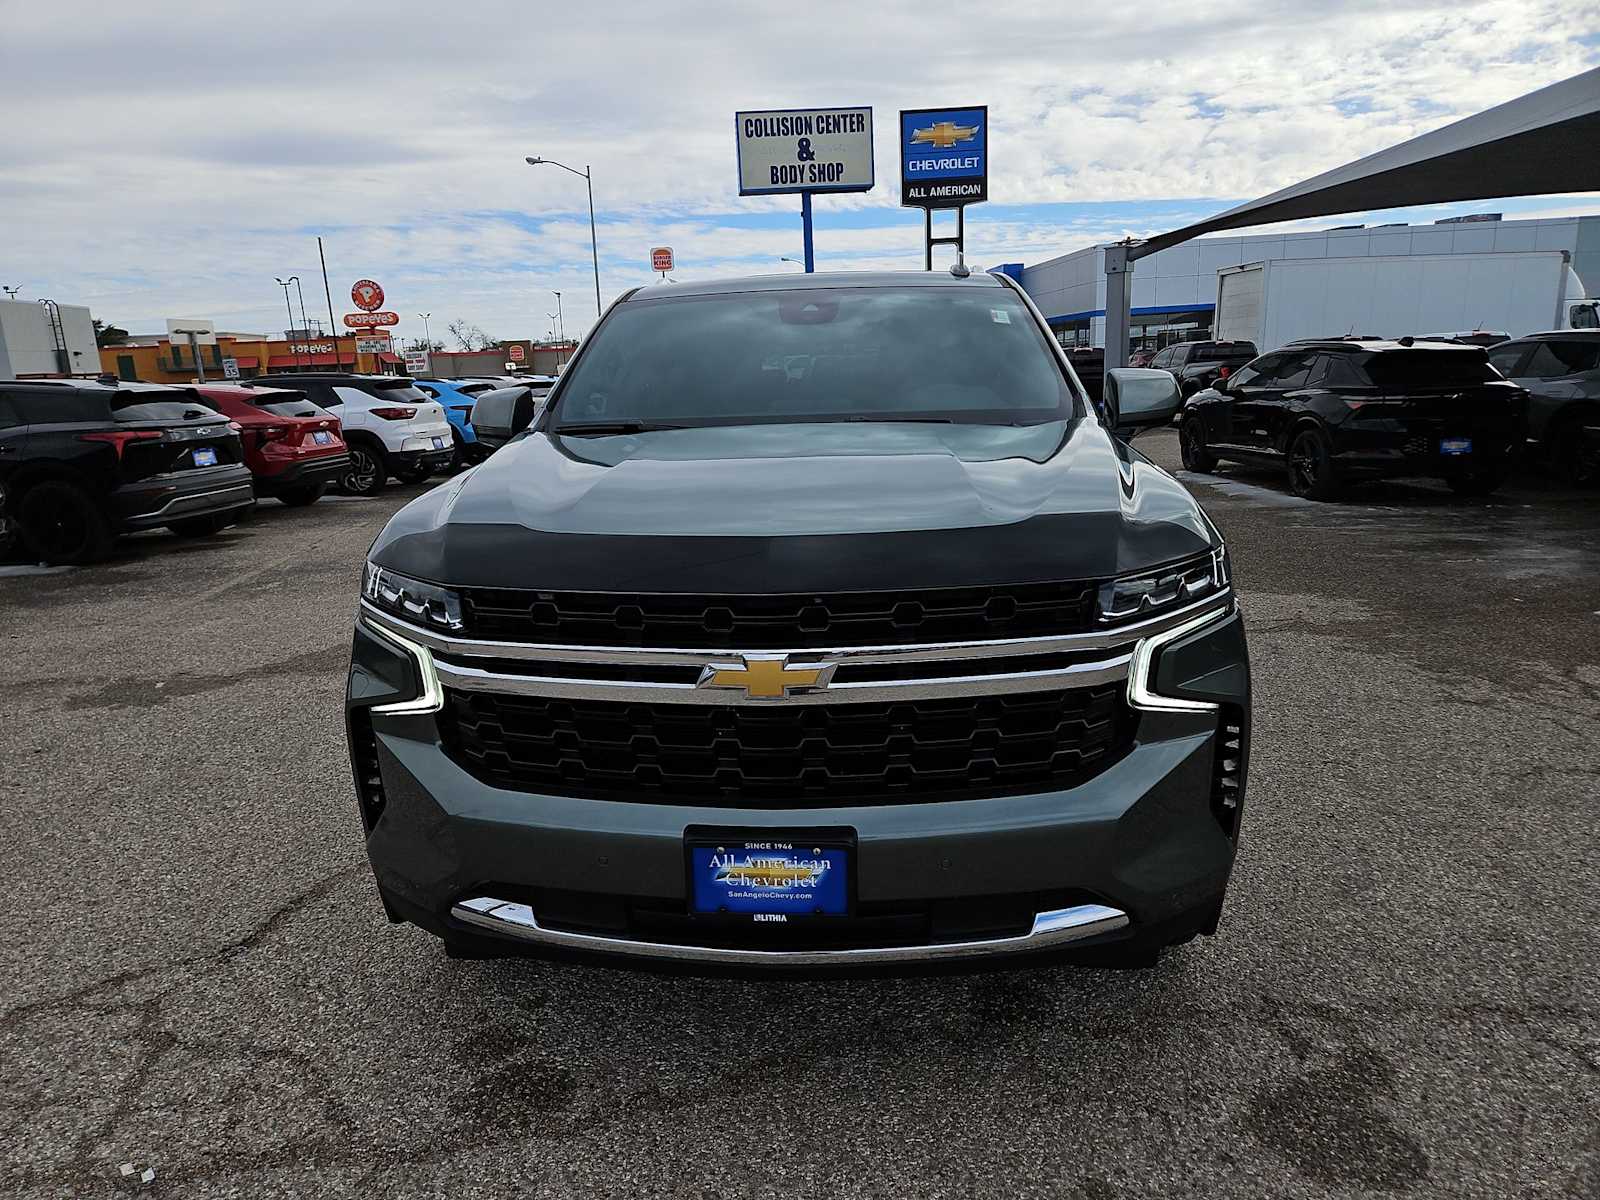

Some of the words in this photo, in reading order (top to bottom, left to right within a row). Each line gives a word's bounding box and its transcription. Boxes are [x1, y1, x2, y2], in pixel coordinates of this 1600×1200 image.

[744, 115, 813, 138] COLLISION
[815, 113, 865, 135] CENTER
[797, 137, 815, 162] &
[908, 156, 980, 172] CHEVROLET
[770, 164, 807, 185] BODY
[808, 162, 844, 183] SHOP
[908, 187, 927, 198] ALL
[929, 184, 981, 197] AMERICAN
[225, 369, 238, 377] 35
[745, 842, 771, 850] SINCE
[709, 855, 736, 868] All
[742, 856, 831, 870] American
[726, 873, 817, 888] Chevrolet
[728, 891, 812, 900] SanAngeloChevy.com
[761, 914, 787, 922] LITHIA
